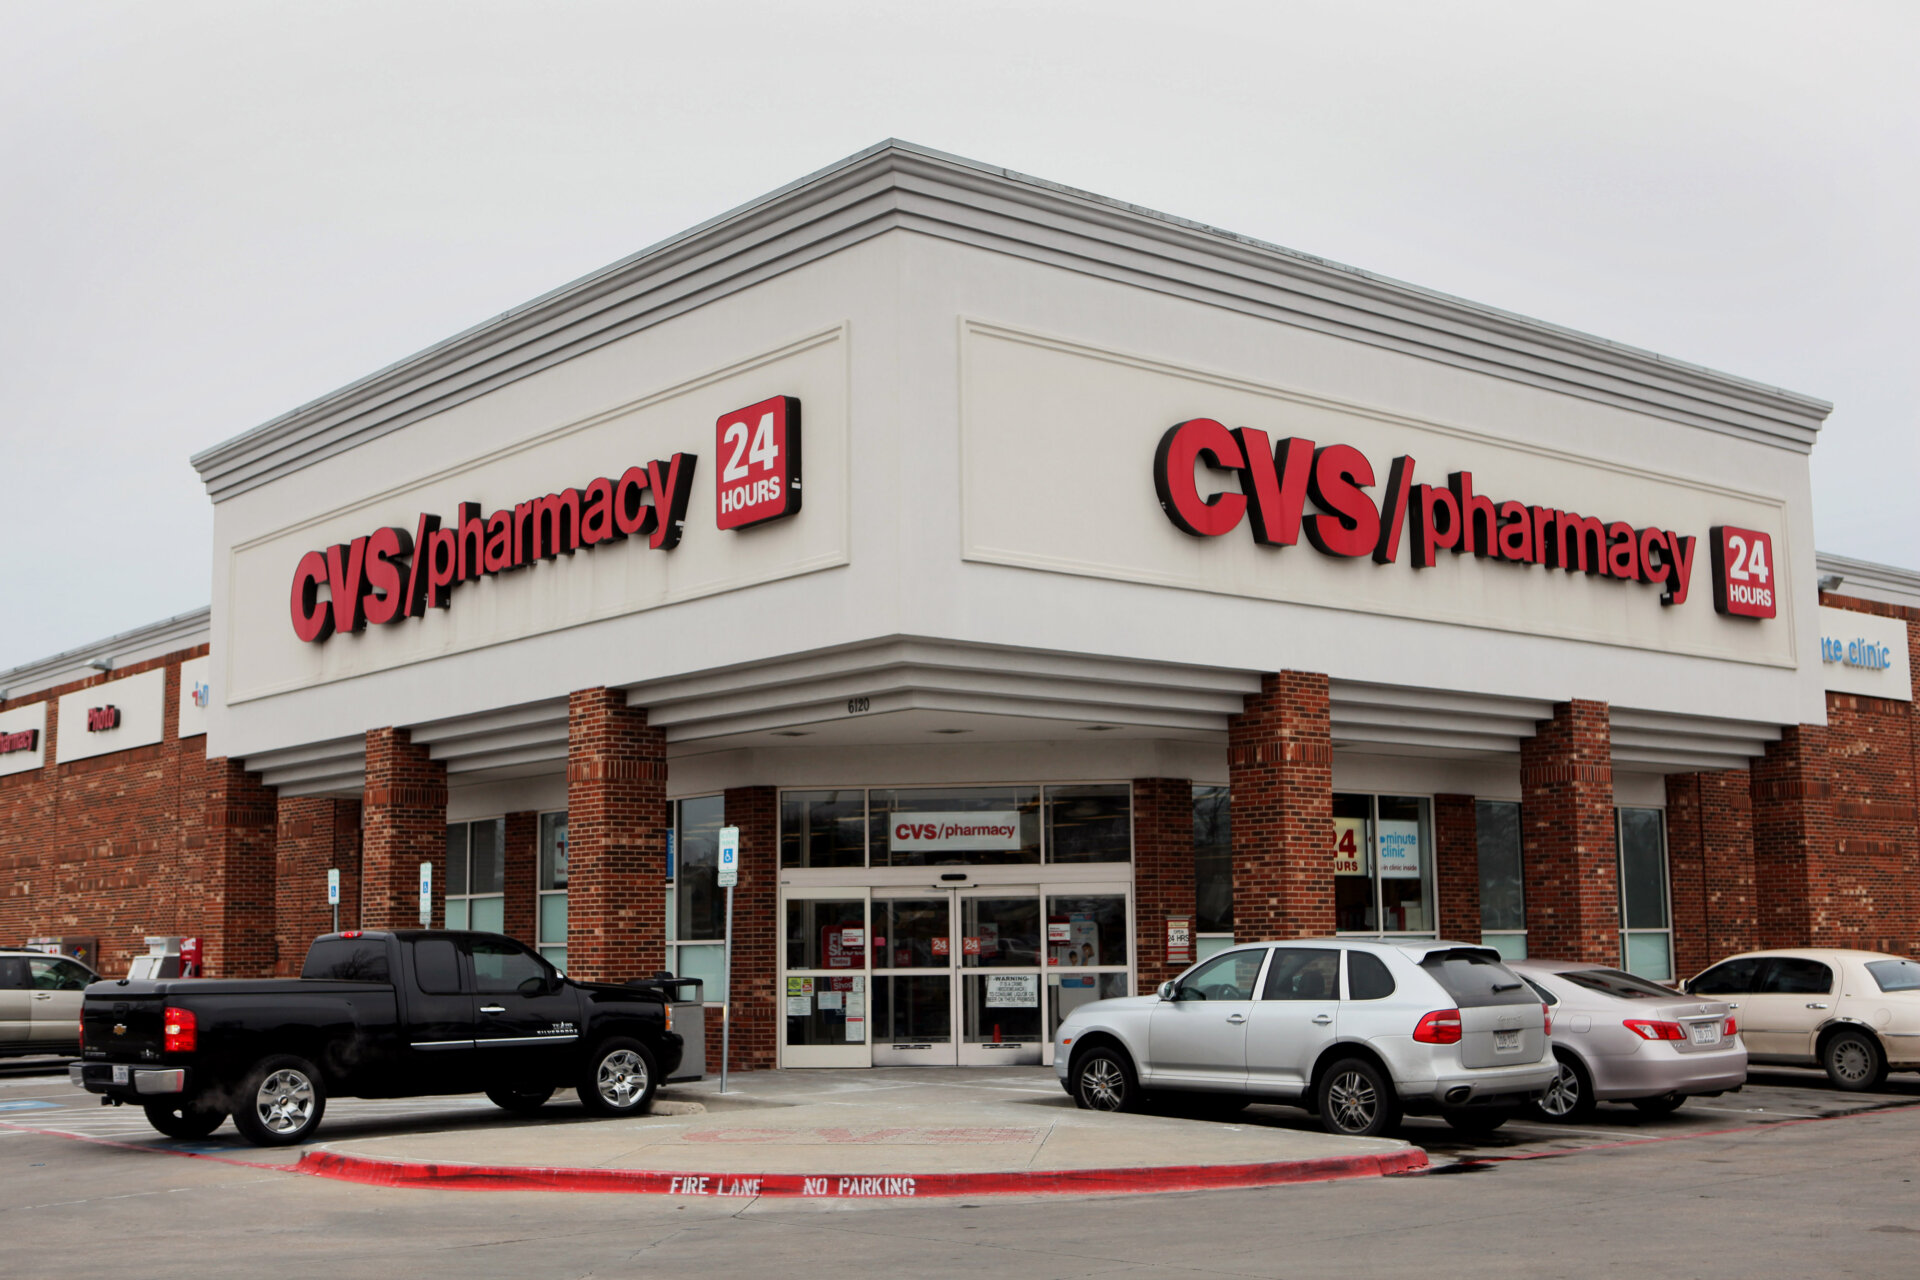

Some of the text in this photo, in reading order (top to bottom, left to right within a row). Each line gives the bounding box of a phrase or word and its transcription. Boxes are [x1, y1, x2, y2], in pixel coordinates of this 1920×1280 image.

[723, 411, 779, 483] 24
[721, 476, 780, 514] HOURS
[1155, 418, 1696, 606] CVS/pharmacy
[291, 452, 697, 642] CVS/pharmacy
[1728, 535, 1769, 583] 24
[1729, 582, 1773, 608] HOURS
[1848, 638, 1891, 669] clinic
[848, 697, 870, 714] 6120
[87, 706, 117, 732] Photo
[895, 823, 1016, 840] CVS/pharmacy
[1386, 832, 1417, 845] minute
[1381, 846, 1406, 858] clinic
[934, 940, 947, 951] 24
[965, 940, 978, 951] 24
[669, 1176, 916, 1196] FIRE LANE NO PARKING
